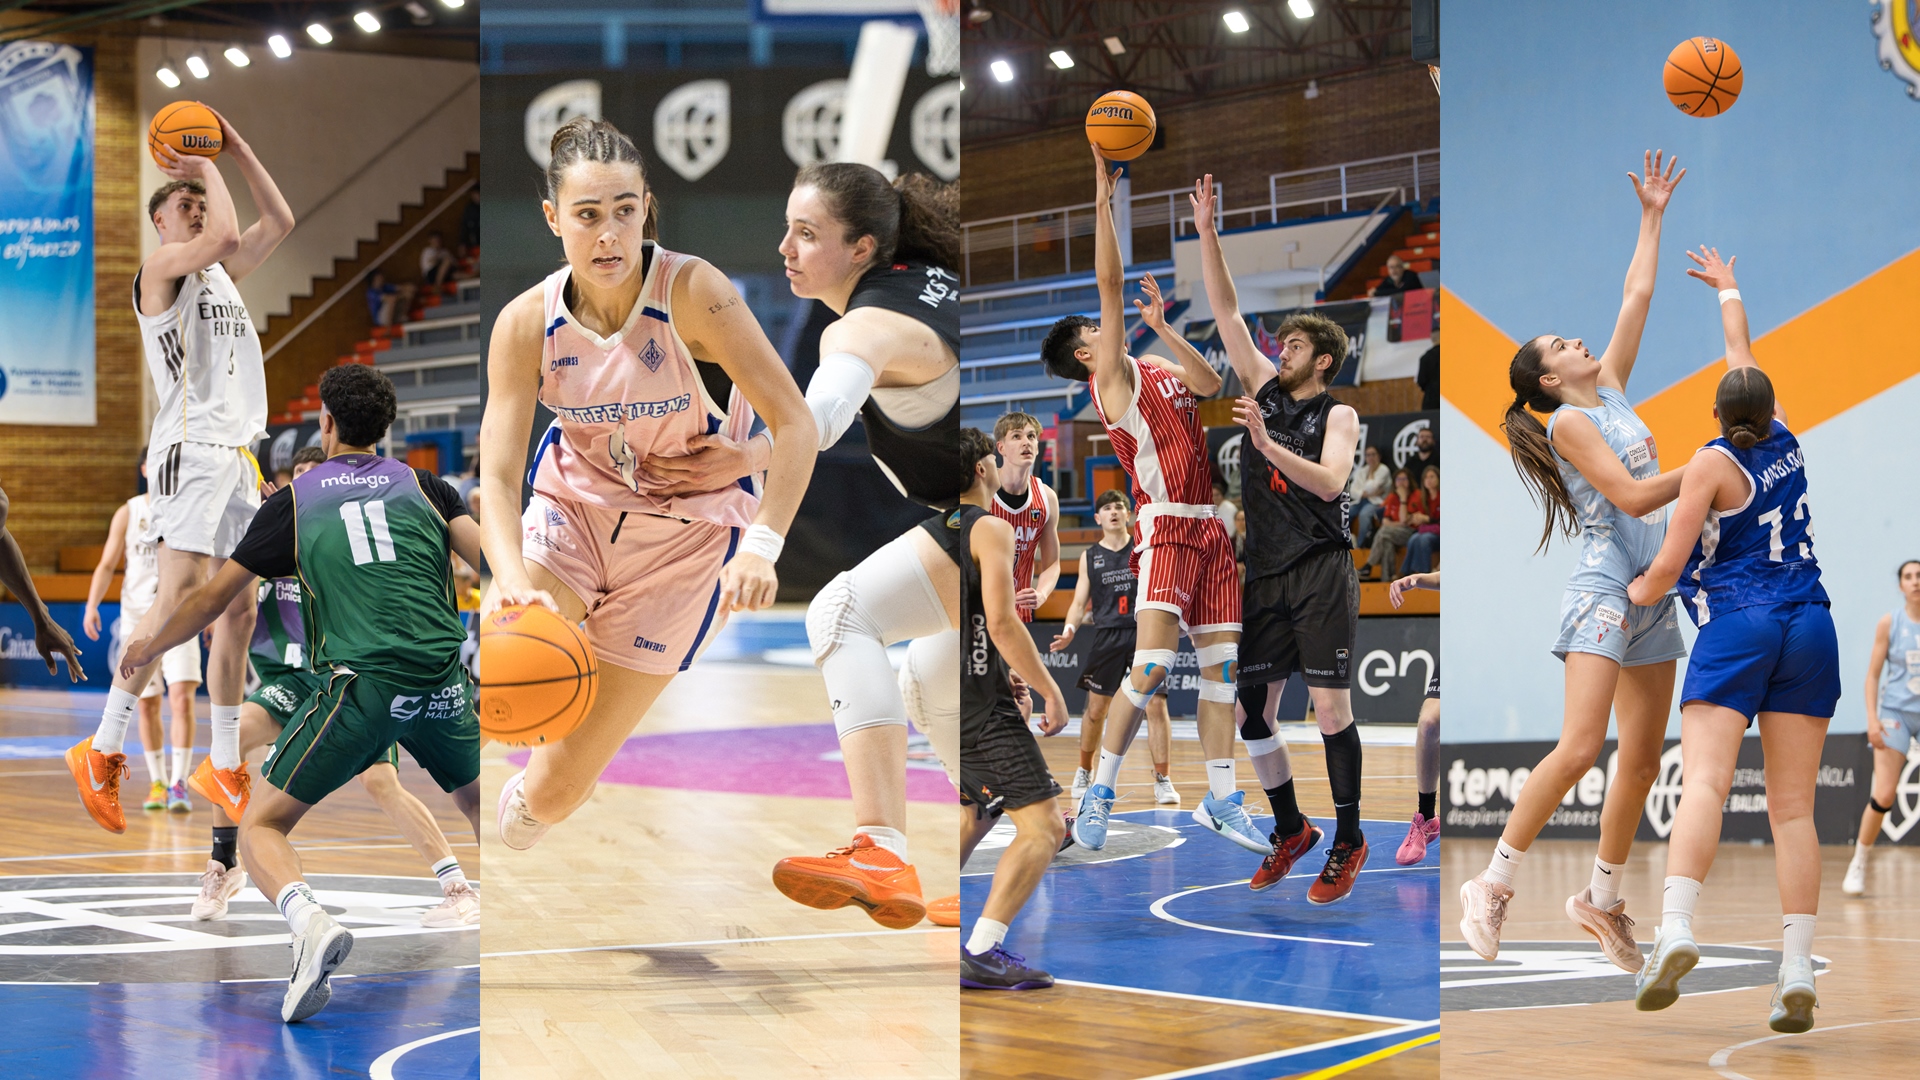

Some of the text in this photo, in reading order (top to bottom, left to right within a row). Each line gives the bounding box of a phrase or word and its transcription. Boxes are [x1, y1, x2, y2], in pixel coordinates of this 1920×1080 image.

[1090, 105, 1134, 121] Wilson
[320, 472, 390, 489] málaga
[339, 500, 397, 566] 11
[1113, 582, 1132, 592] 2031
[1118, 595, 1128, 615] 8
[971, 613, 988, 676] CASTOR
[284, 643, 303, 668] 4
[1305, 667, 1335, 676] BERNER
[428, 701, 451, 711] DEL
